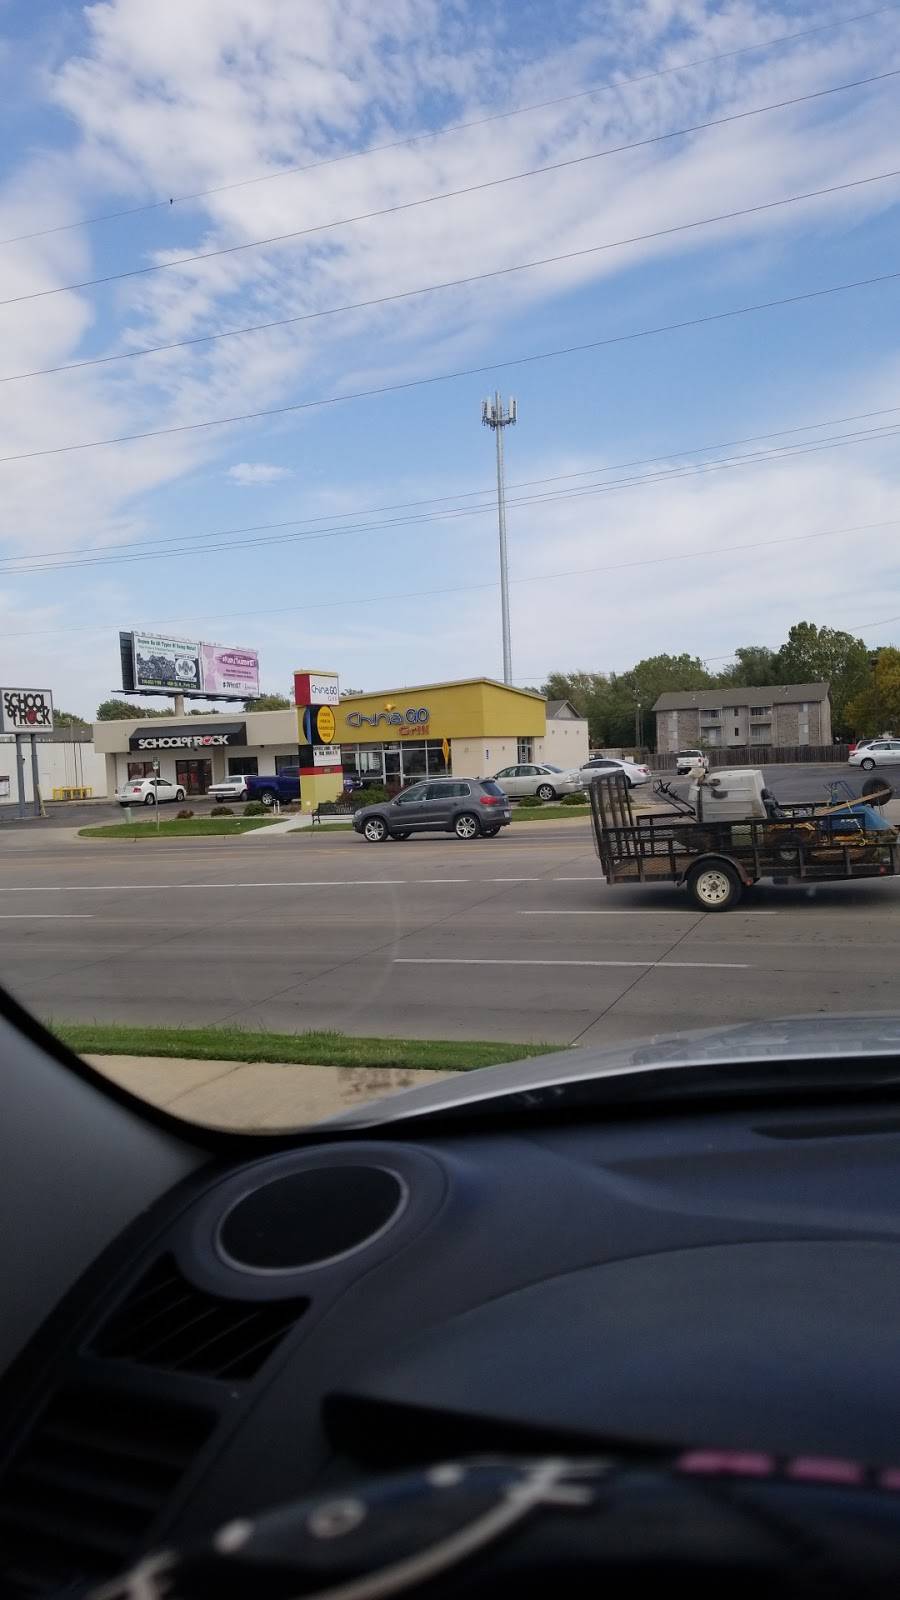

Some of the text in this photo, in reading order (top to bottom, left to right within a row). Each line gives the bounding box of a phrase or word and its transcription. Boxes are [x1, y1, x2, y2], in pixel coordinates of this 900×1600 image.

[311, 684, 338, 695] China GO
[4, 692, 46, 709] SCHOOL
[19, 705, 51, 725] ROCK
[346, 706, 430, 727] China GO
[398, 725, 430, 736] Grill
[138, 737, 185, 749] SCHOOL
[192, 734, 230, 746] ROCK
